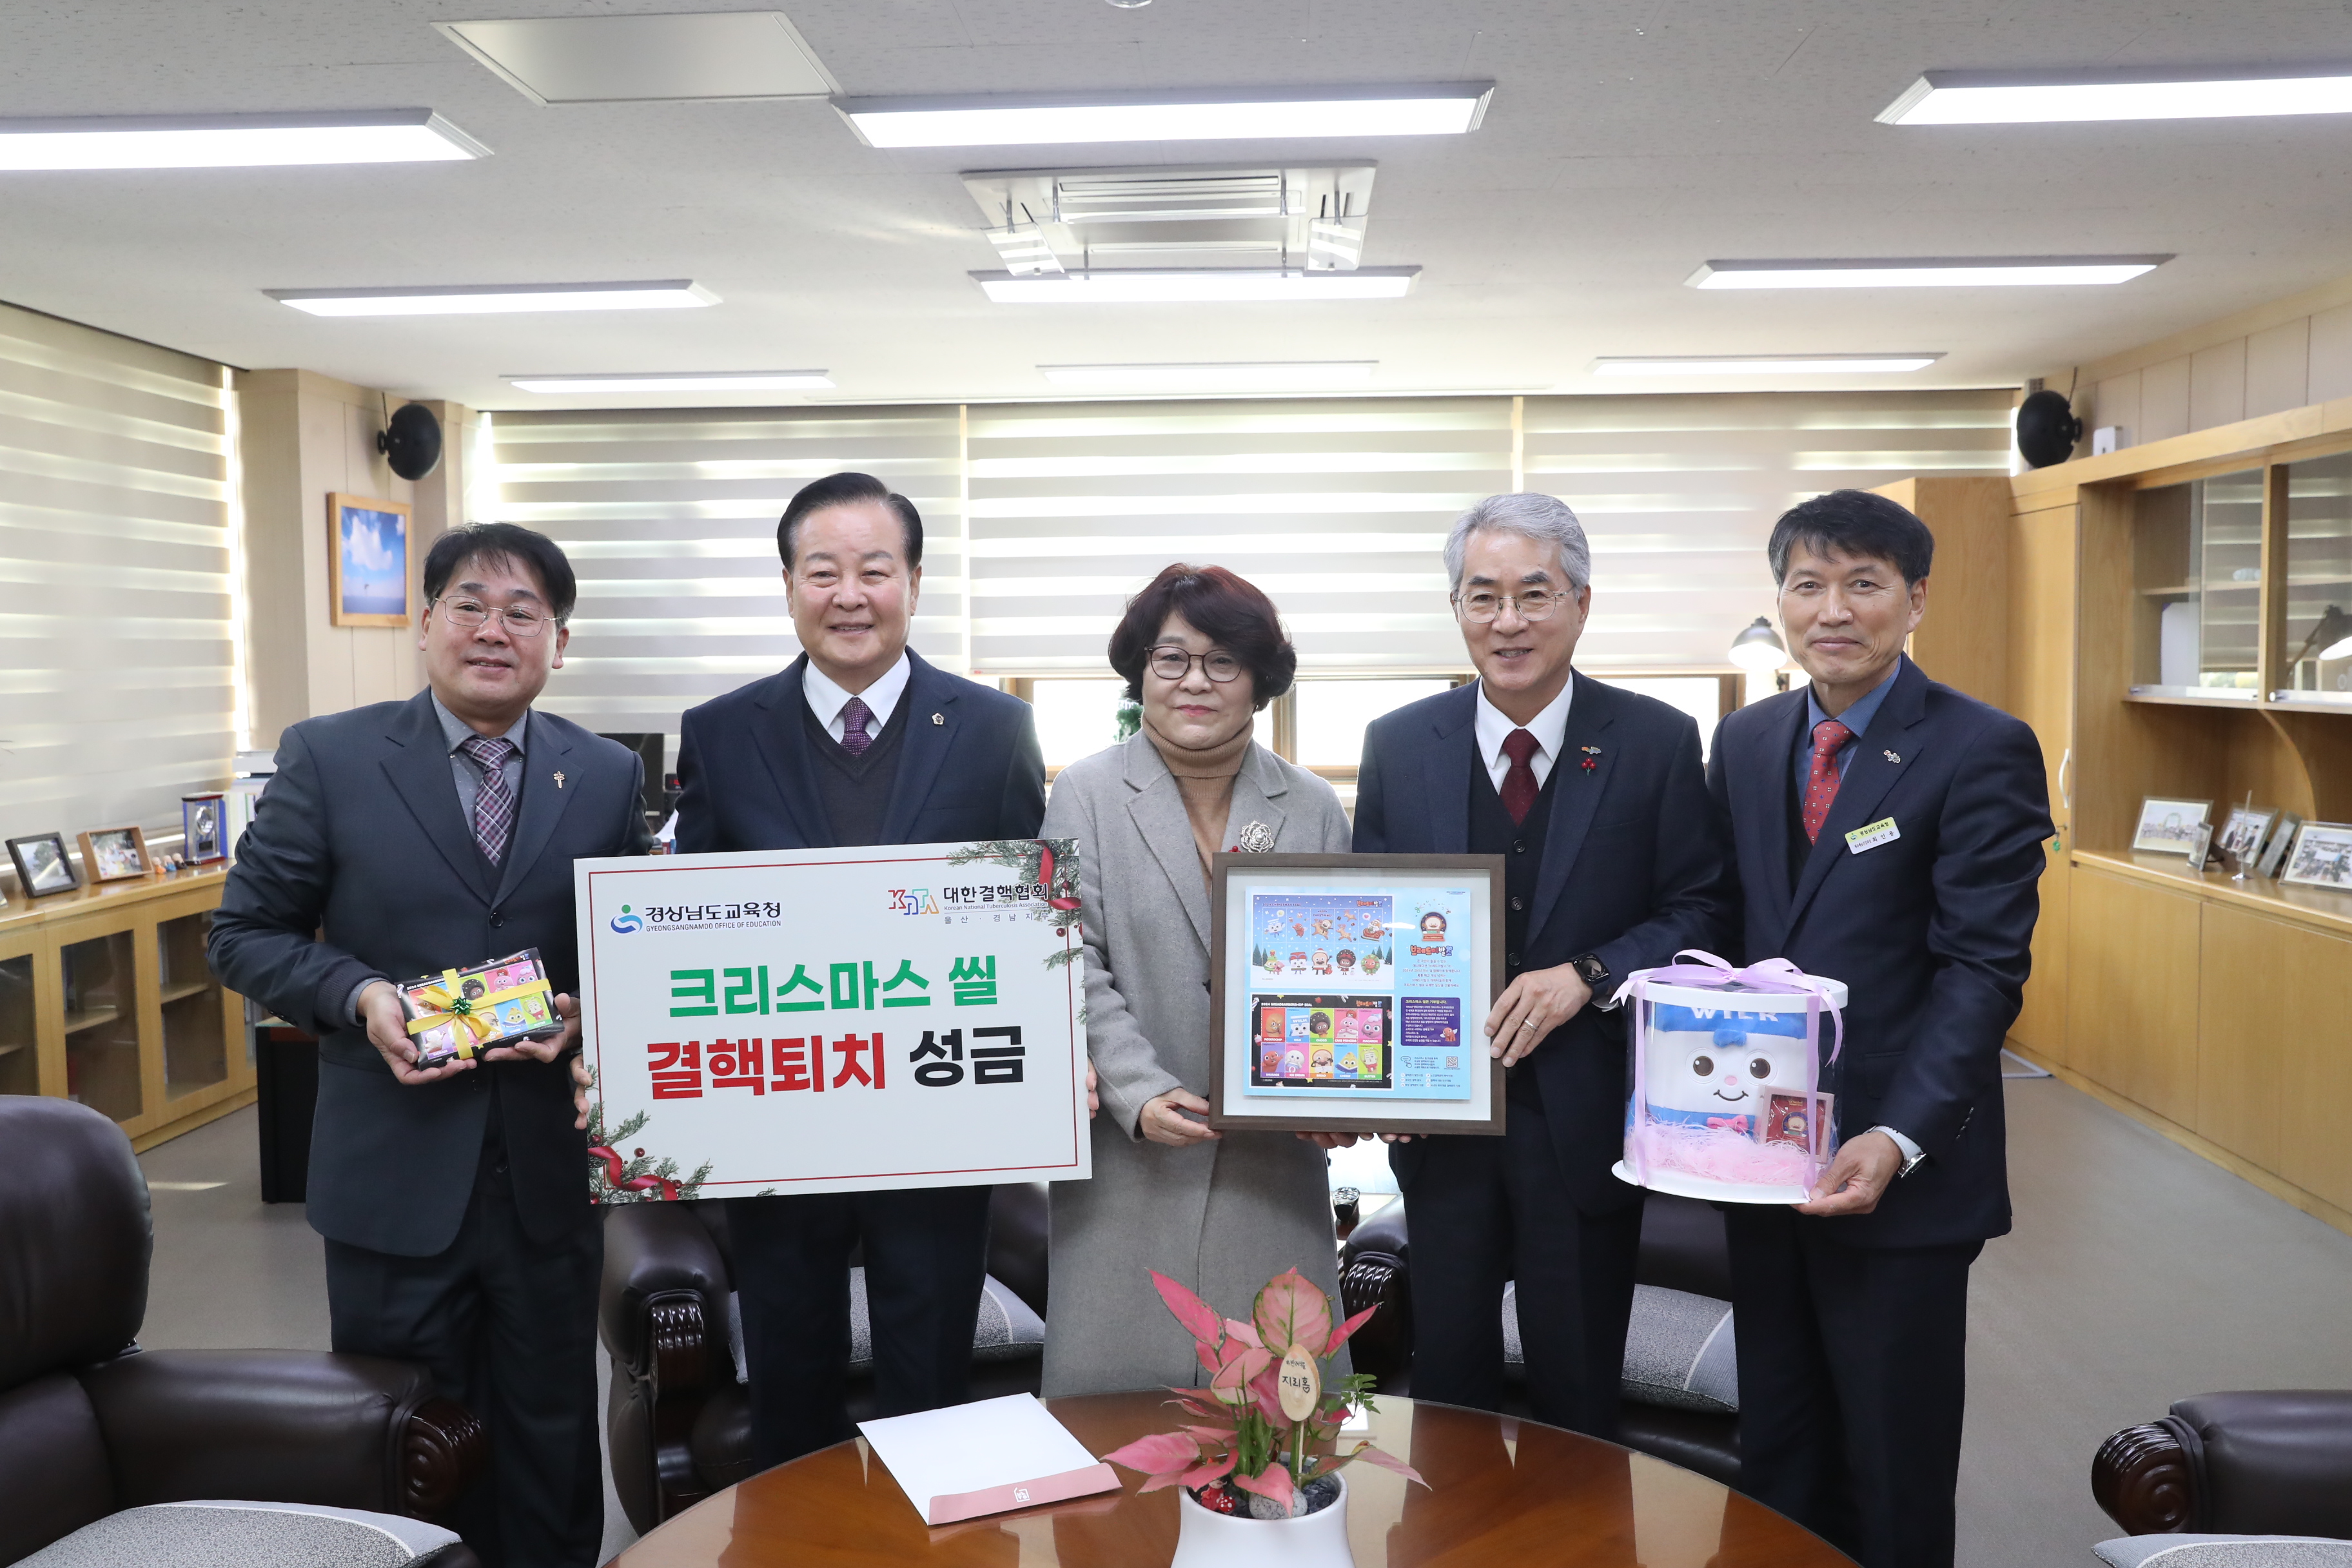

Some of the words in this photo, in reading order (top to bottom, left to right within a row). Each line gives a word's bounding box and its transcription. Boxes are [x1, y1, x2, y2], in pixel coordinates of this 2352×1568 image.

[1859, 821, 1889, 836] 경상남도교육청
[943, 883, 1048, 903] 대한결핵협회
[645, 902, 781, 923] 경상남도교육청
[646, 923, 713, 932] GYEONGSANGNAMDO
[670, 959, 931, 1017] 크리스마스
[948, 955, 998, 1006] 씰
[648, 1032, 885, 1100] 결핵퇴치
[909, 1026, 1026, 1087] 성금
